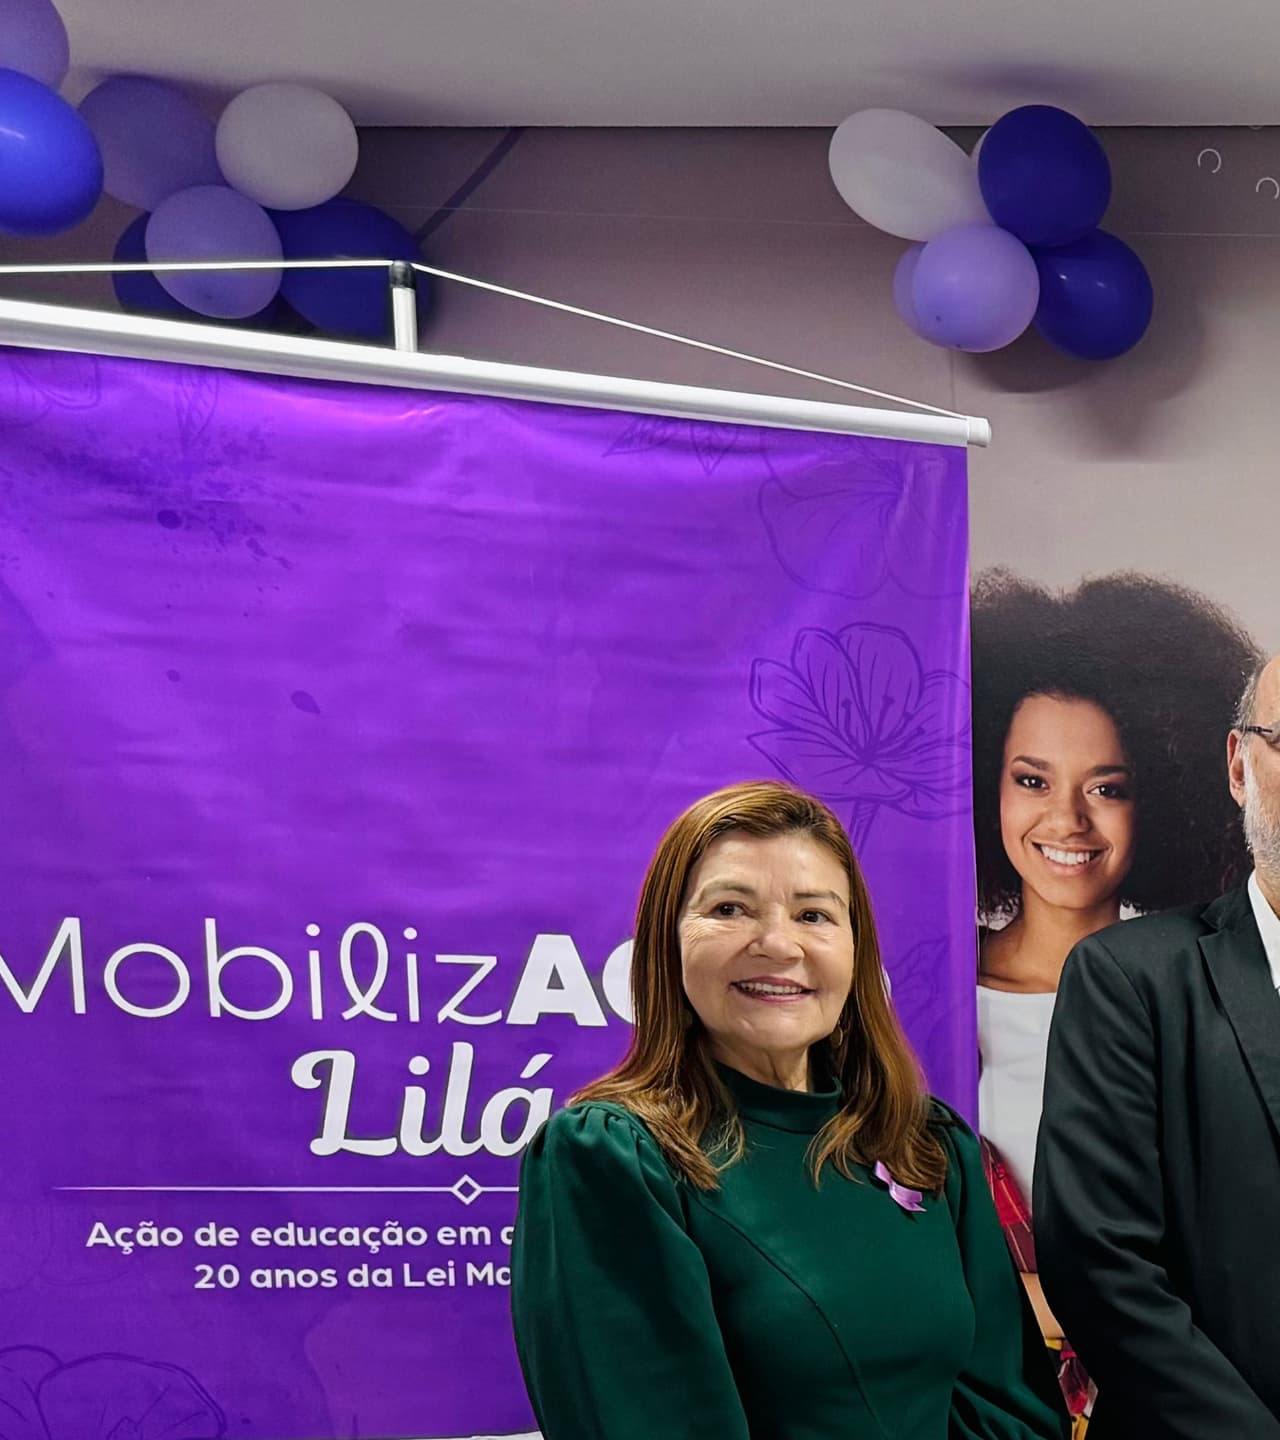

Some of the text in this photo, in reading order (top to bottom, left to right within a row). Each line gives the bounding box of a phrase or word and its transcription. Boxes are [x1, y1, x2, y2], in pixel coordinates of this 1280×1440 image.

[291, 1042, 555, 1157] Lilá
[86, 1221, 184, 1254] Ação
[194, 1222, 240, 1247] de
[250, 1220, 428, 1253] educação
[436, 1226, 492, 1247] em
[194, 1264, 240, 1289] 20
[250, 1267, 338, 1289] anos
[347, 1262, 393, 1288] da
[403, 1260, 455, 1288] Lei
